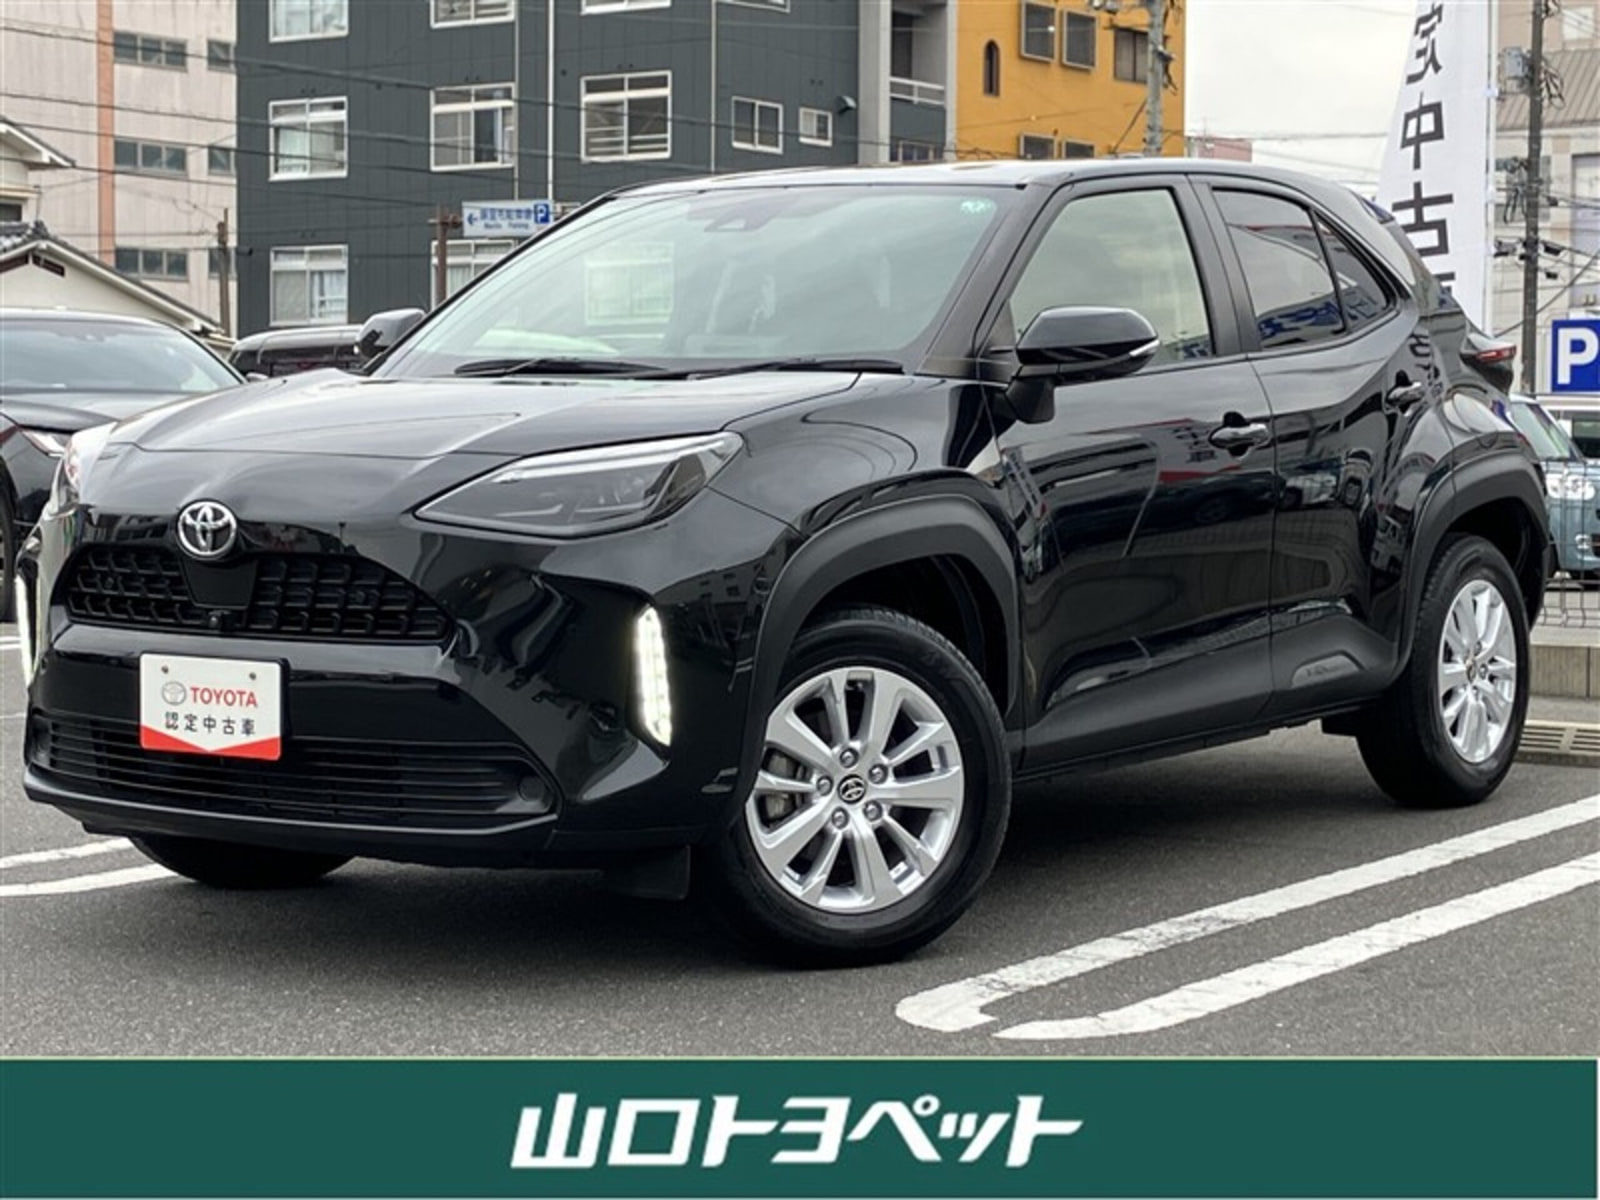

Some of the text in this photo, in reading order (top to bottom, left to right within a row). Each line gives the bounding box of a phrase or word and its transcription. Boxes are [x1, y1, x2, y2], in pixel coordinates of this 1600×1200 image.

[1391, 3, 1455, 294] 定中古
[537, 205, 547, 222] P
[1558, 328, 1599, 385] P
[190, 686, 257, 708] TOYOTA
[164, 711, 256, 736] 認定中古車
